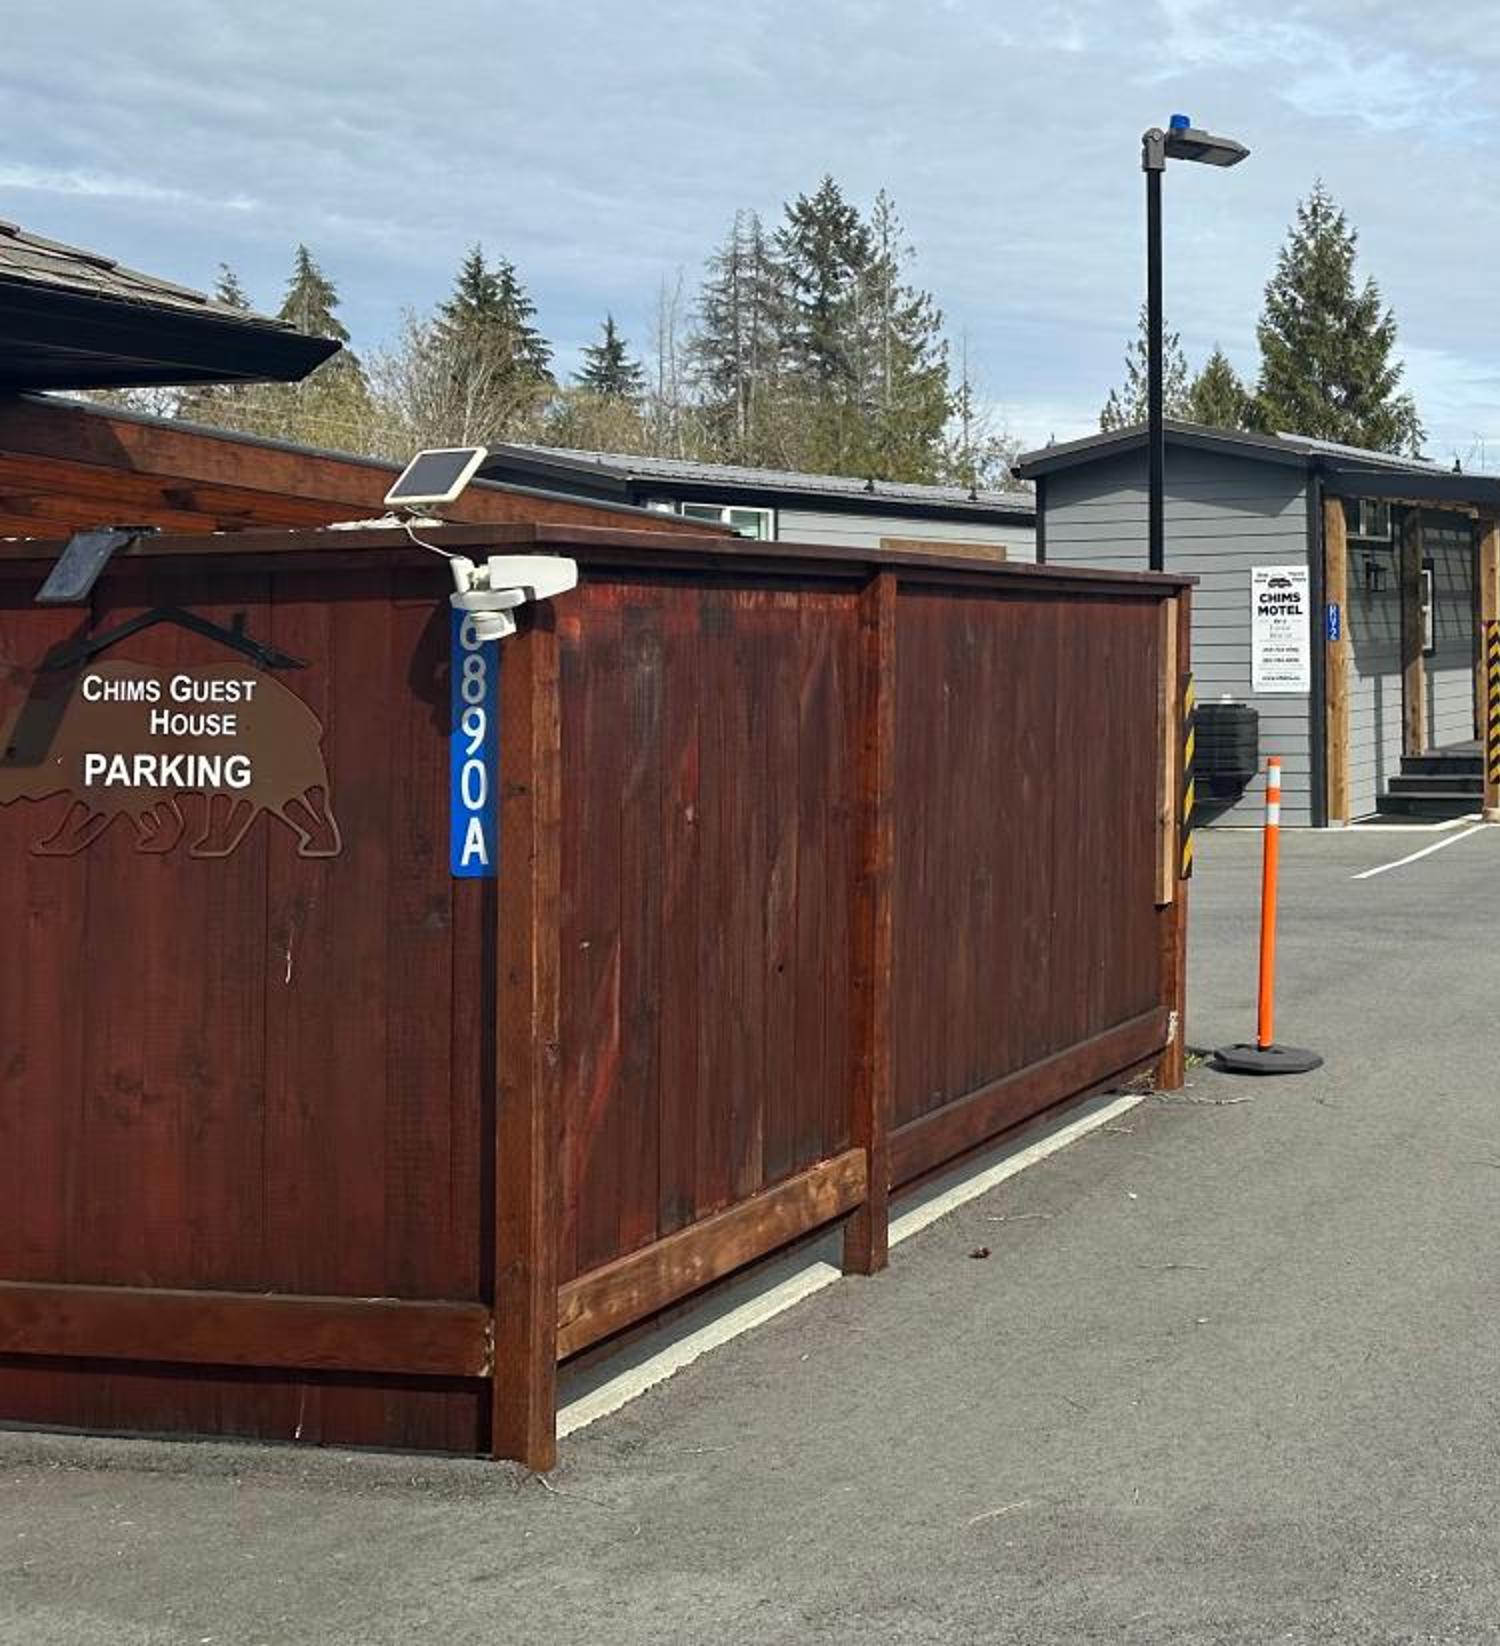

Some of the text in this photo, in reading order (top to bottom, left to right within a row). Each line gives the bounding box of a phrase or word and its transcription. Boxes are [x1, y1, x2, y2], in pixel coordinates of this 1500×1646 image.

[1257, 605, 1304, 616] MOTEL
[1259, 592, 1301, 603] CHIMS
[82, 674, 257, 703] CHIMS GUEST
[150, 709, 237, 736] HOUSE
[459, 611, 489, 866] 6890A
[84, 753, 252, 788] PARKING
